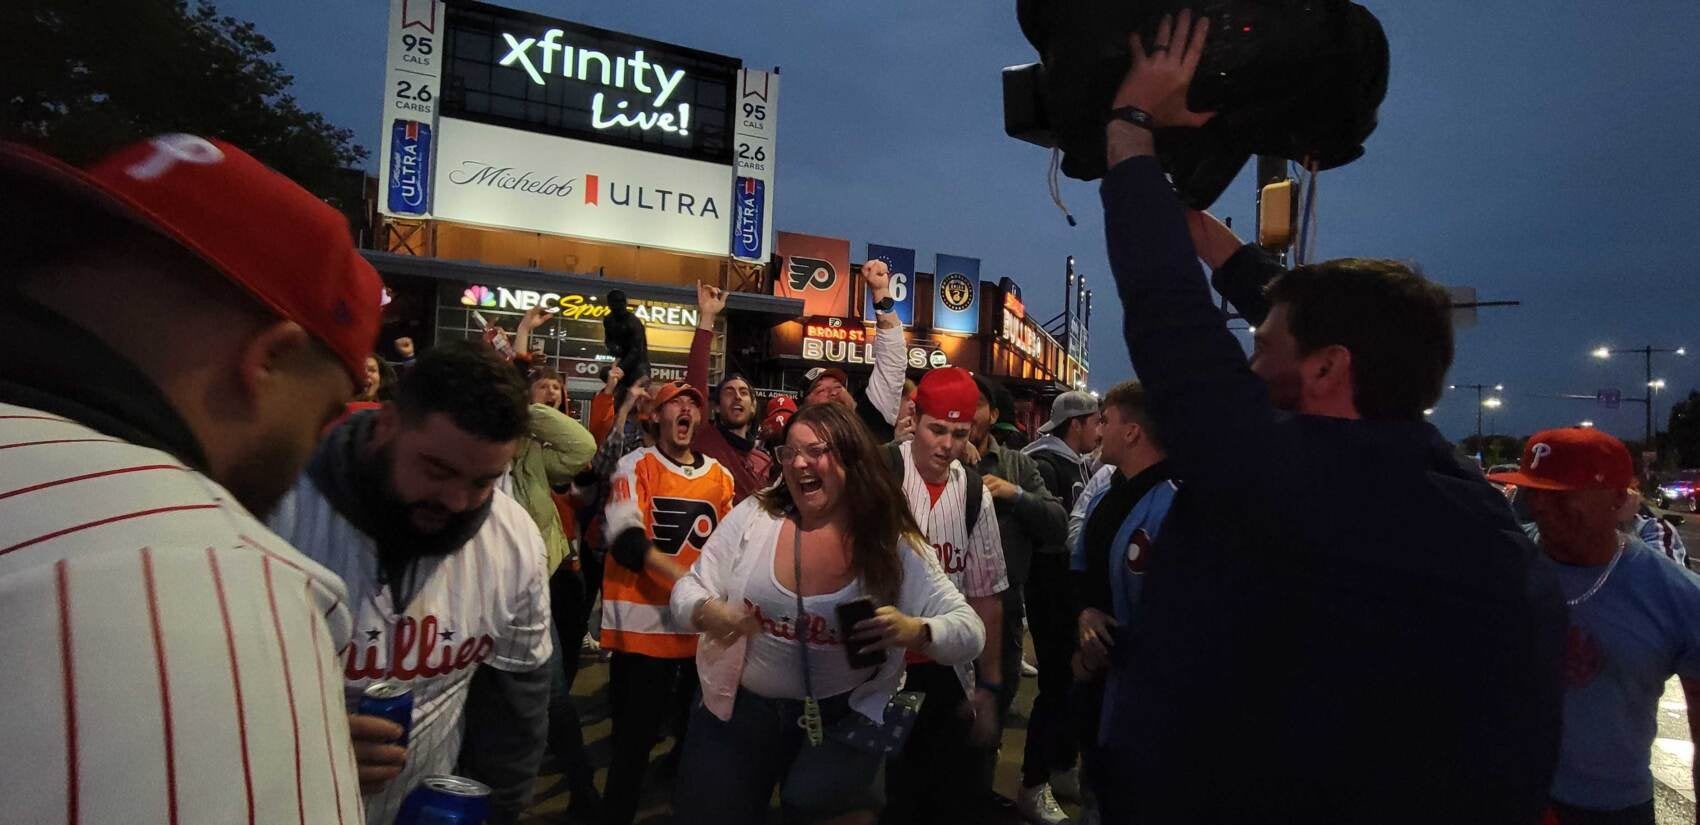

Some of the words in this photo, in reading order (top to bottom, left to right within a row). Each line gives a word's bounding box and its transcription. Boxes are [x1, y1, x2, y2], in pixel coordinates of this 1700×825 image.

[402, 34, 433, 55] 95
[402, 54, 431, 66] CALS
[499, 28, 686, 107] xfinity
[396, 81, 432, 102] 2.6
[395, 101, 432, 114] CARBS
[592, 92, 690, 136] Live!
[742, 103, 766, 121] 95
[743, 120, 764, 130] CALS
[738, 143, 766, 161] 2.6
[401, 143, 418, 197] ULTRA
[738, 160, 766, 172] CARBS
[448, 160, 577, 198] Michelob
[610, 181, 720, 220] ULTRA
[742, 198, 755, 244] ULTRA
[498, 286, 561, 313] NBC
[560, 295, 613, 318] Spor
[635, 304, 699, 328] AREN
[807, 324, 847, 340] BROAD
[802, 338, 928, 368] BULLS
[575, 362, 600, 376] GO
[1530, 442, 1551, 469] P
